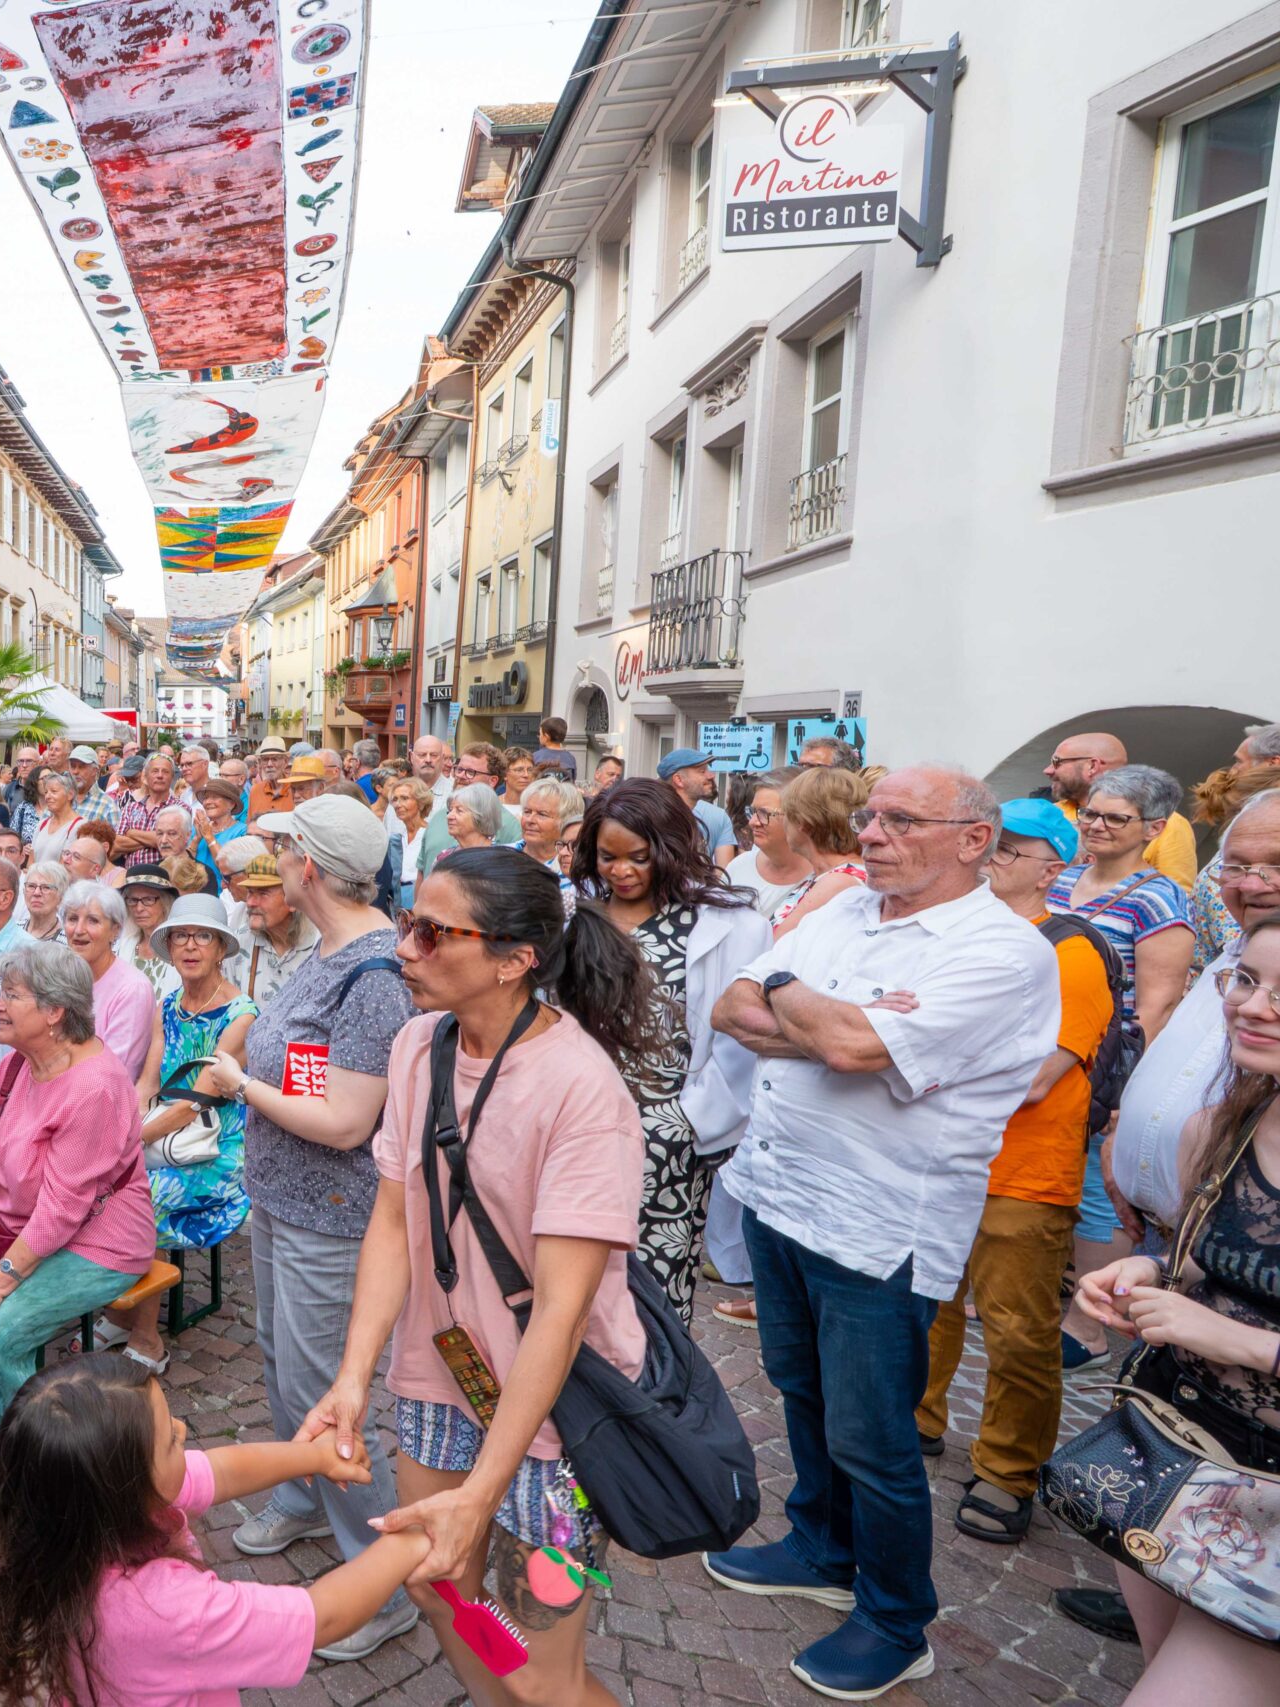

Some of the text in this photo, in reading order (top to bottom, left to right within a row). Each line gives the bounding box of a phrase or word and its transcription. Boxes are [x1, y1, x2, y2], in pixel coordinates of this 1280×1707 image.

[794, 108, 836, 146] il
[732, 158, 899, 204] Martino
[732, 200, 889, 232] Ristorante
[845, 700, 858, 718] 36
[704, 741, 742, 749] Korngasse
[289, 1051, 312, 1096] JAZZ
[309, 1051, 329, 1095] FEST
